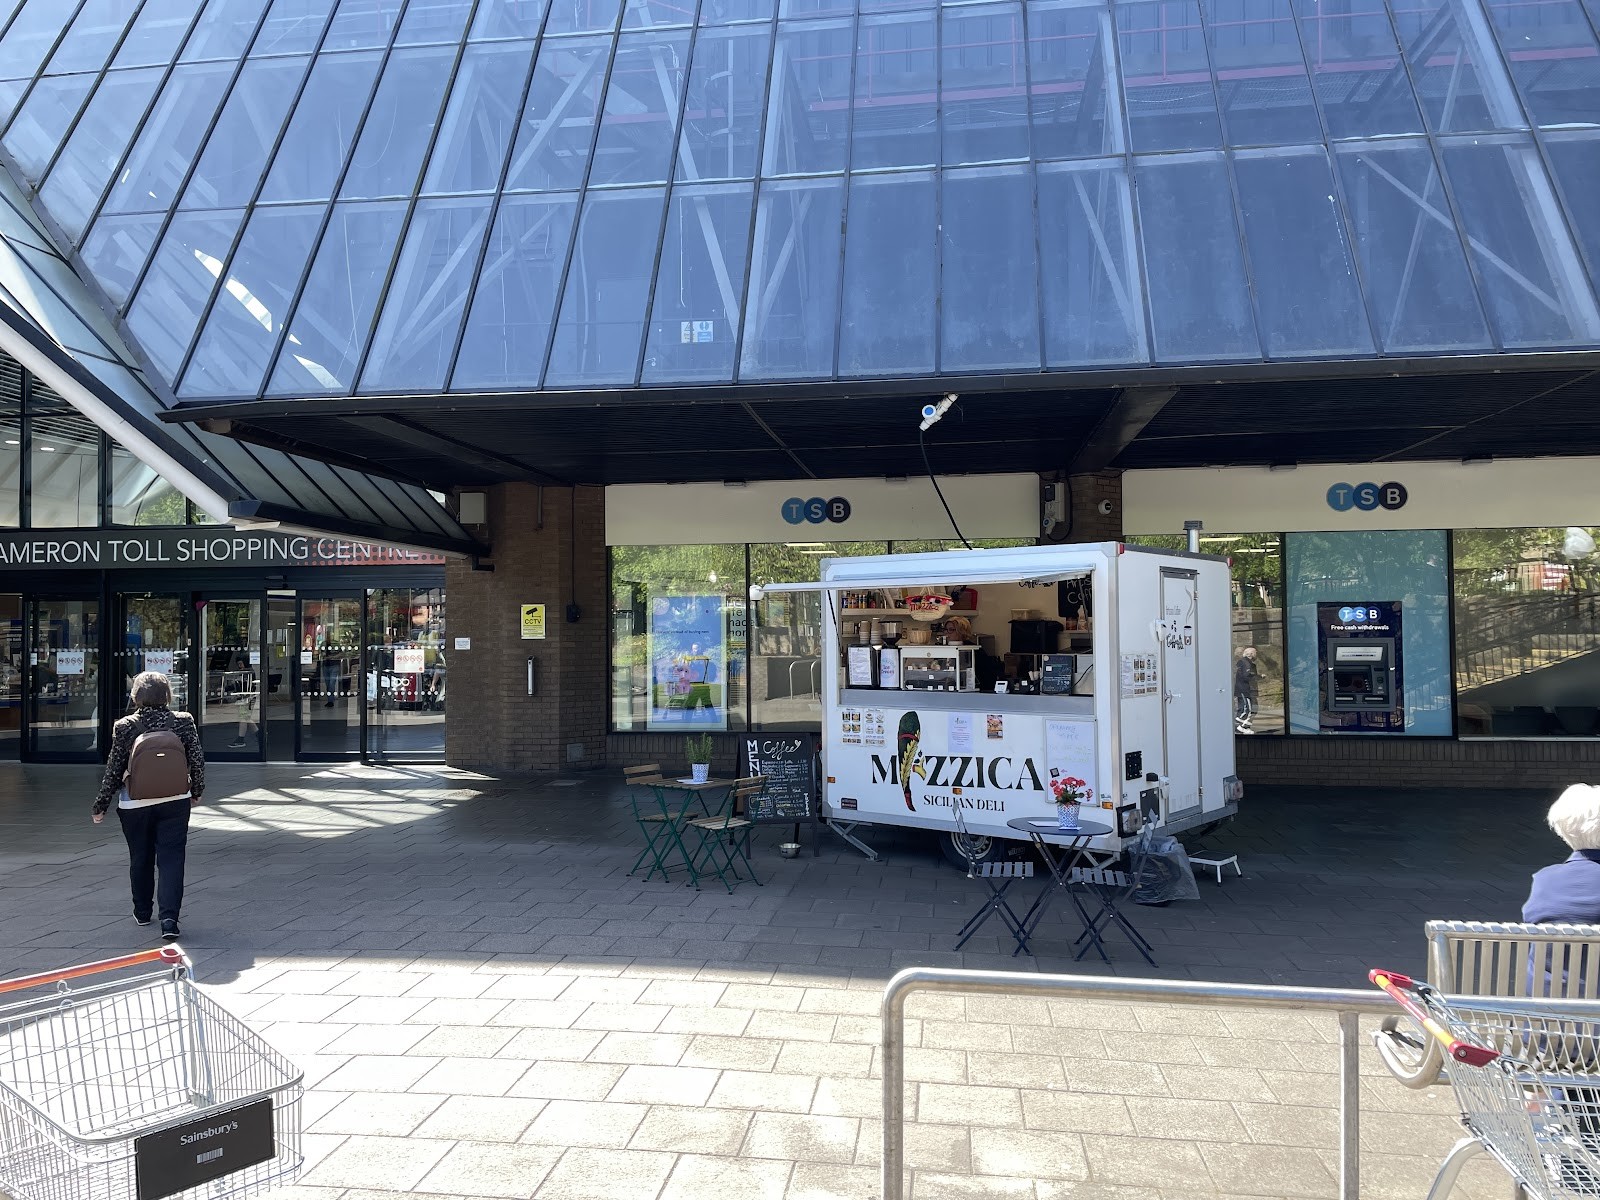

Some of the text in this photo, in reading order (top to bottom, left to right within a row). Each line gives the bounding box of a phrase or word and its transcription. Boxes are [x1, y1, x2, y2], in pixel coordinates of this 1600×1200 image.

[1331, 485, 1404, 508] TSB
[785, 500, 848, 521] TSB
[108, 539, 170, 562] TOLL
[176, 537, 309, 562] SHOPPING
[1341, 608, 1379, 620] TSB
[763, 740, 801, 760] Coffee
[976, 799, 1005, 812] DELI
[180, 1120, 239, 1146] Sainsbury's
